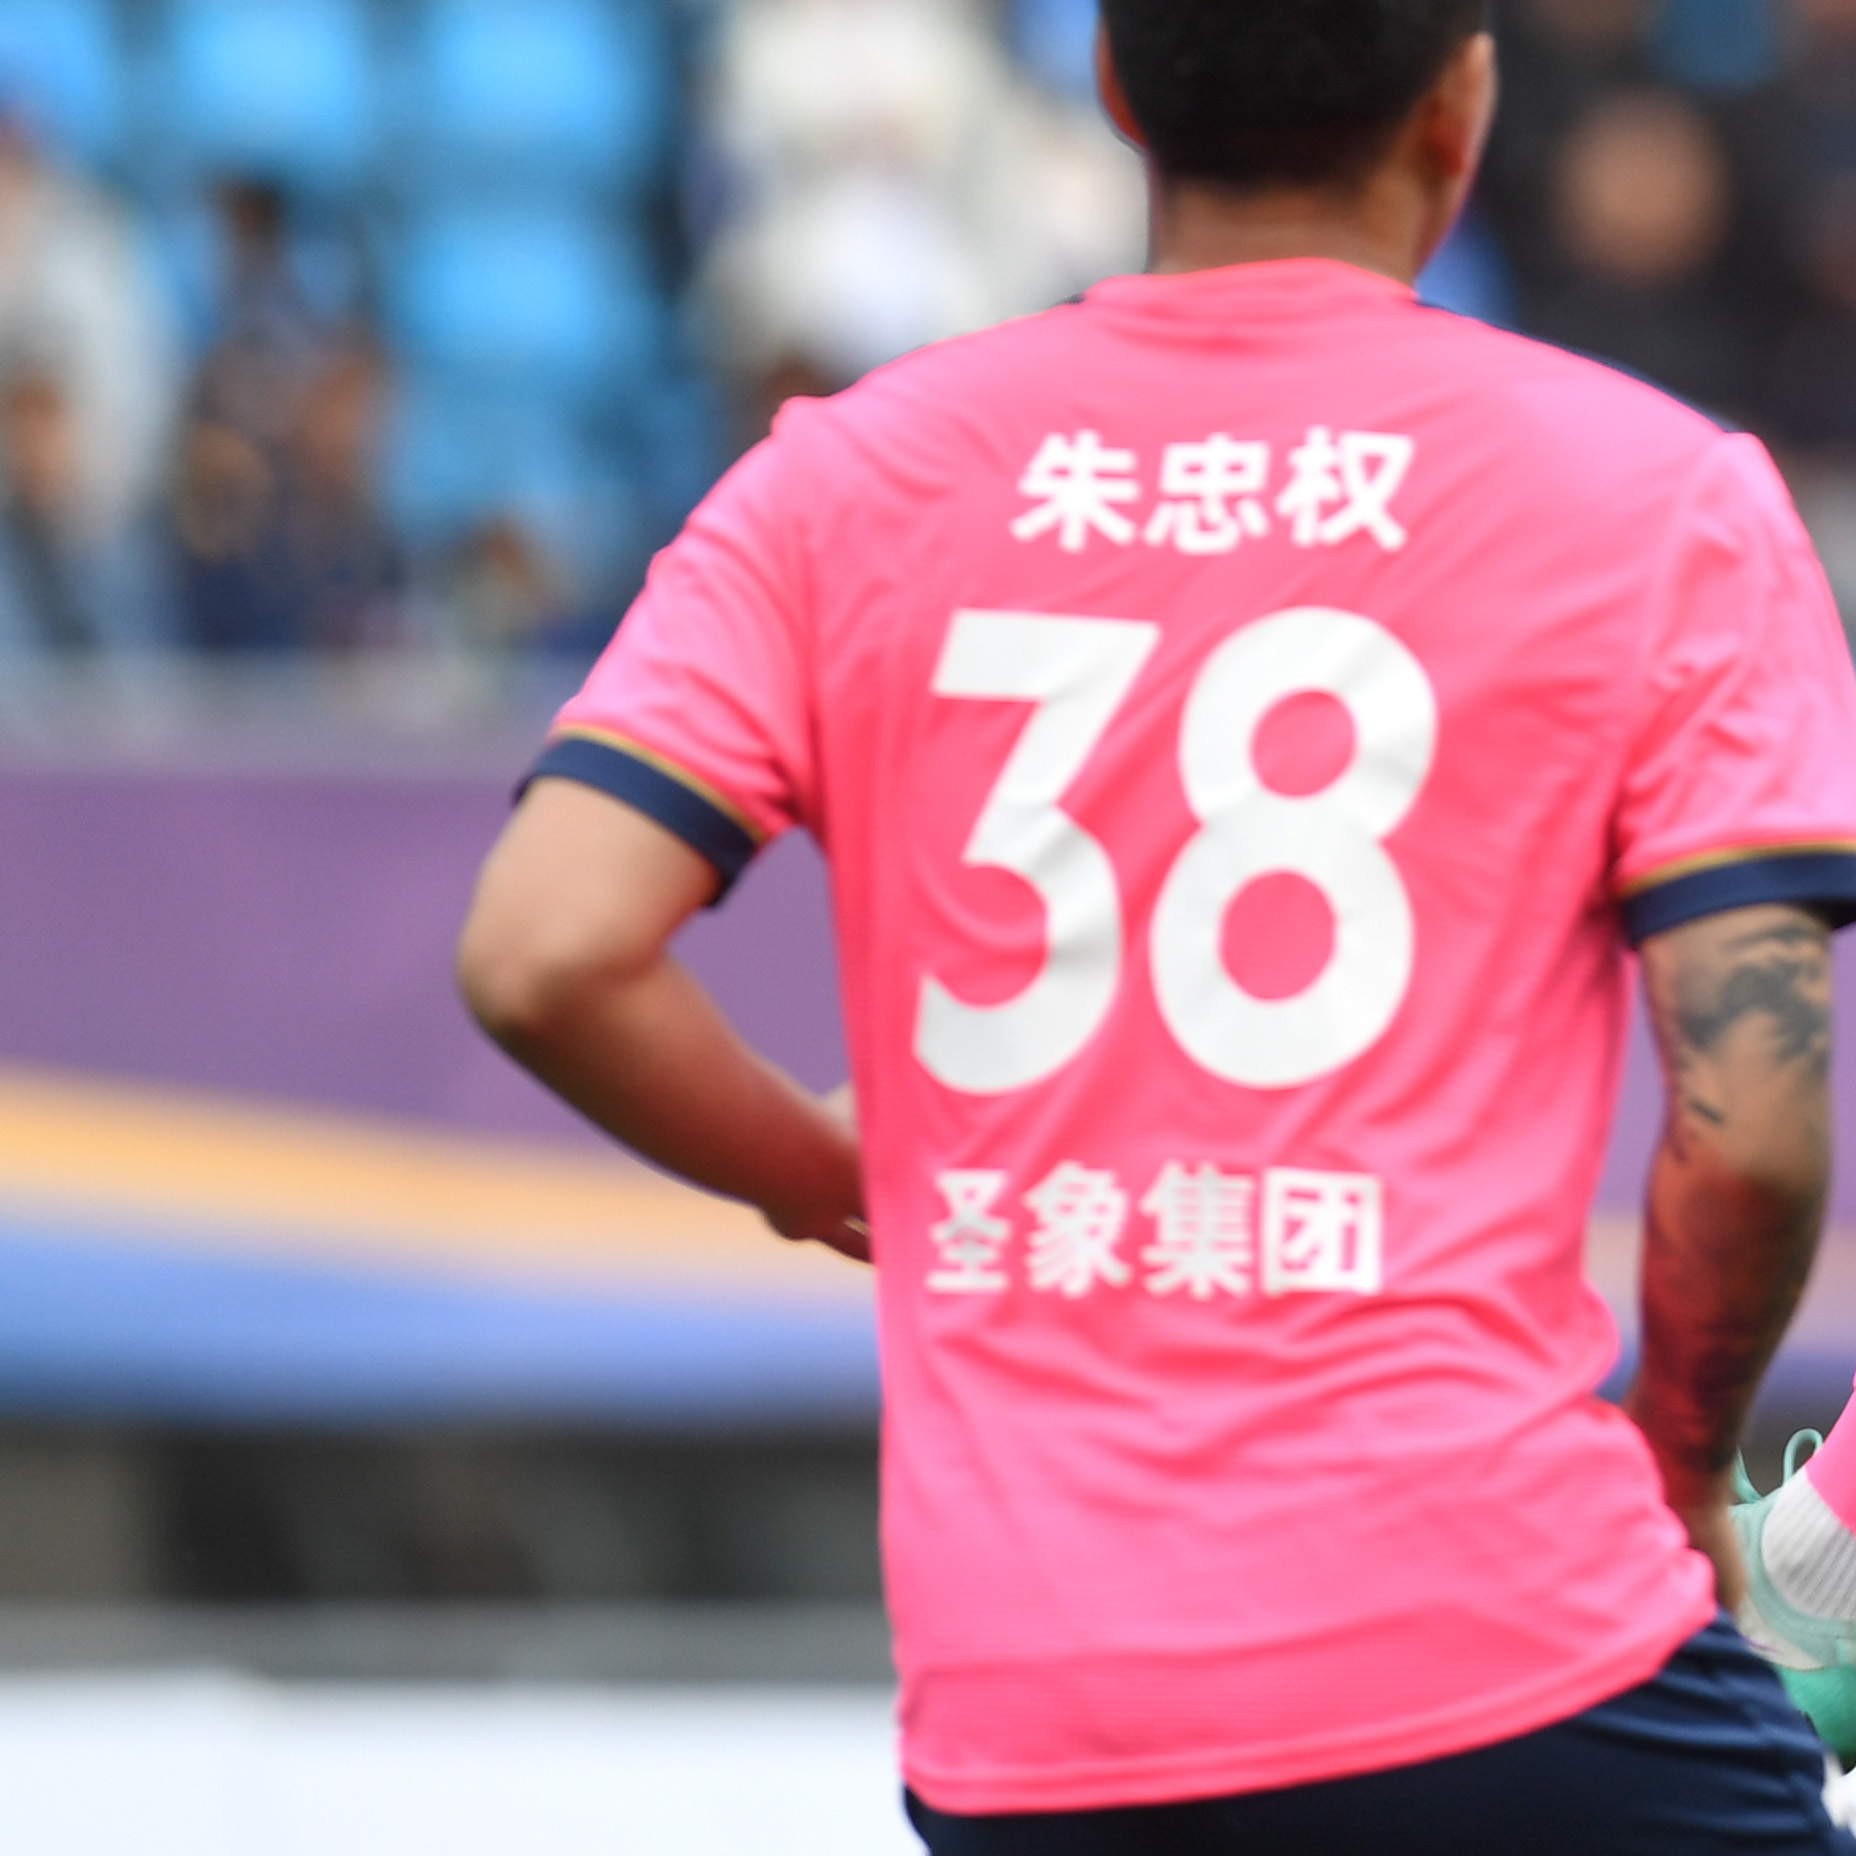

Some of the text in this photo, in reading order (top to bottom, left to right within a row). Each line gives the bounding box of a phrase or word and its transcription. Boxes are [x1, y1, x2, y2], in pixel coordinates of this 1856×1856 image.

[1010, 425, 1415, 554] 朱忠权
[912, 606, 1438, 1095] 38
[925, 1161, 1384, 1298] 圣象集团
